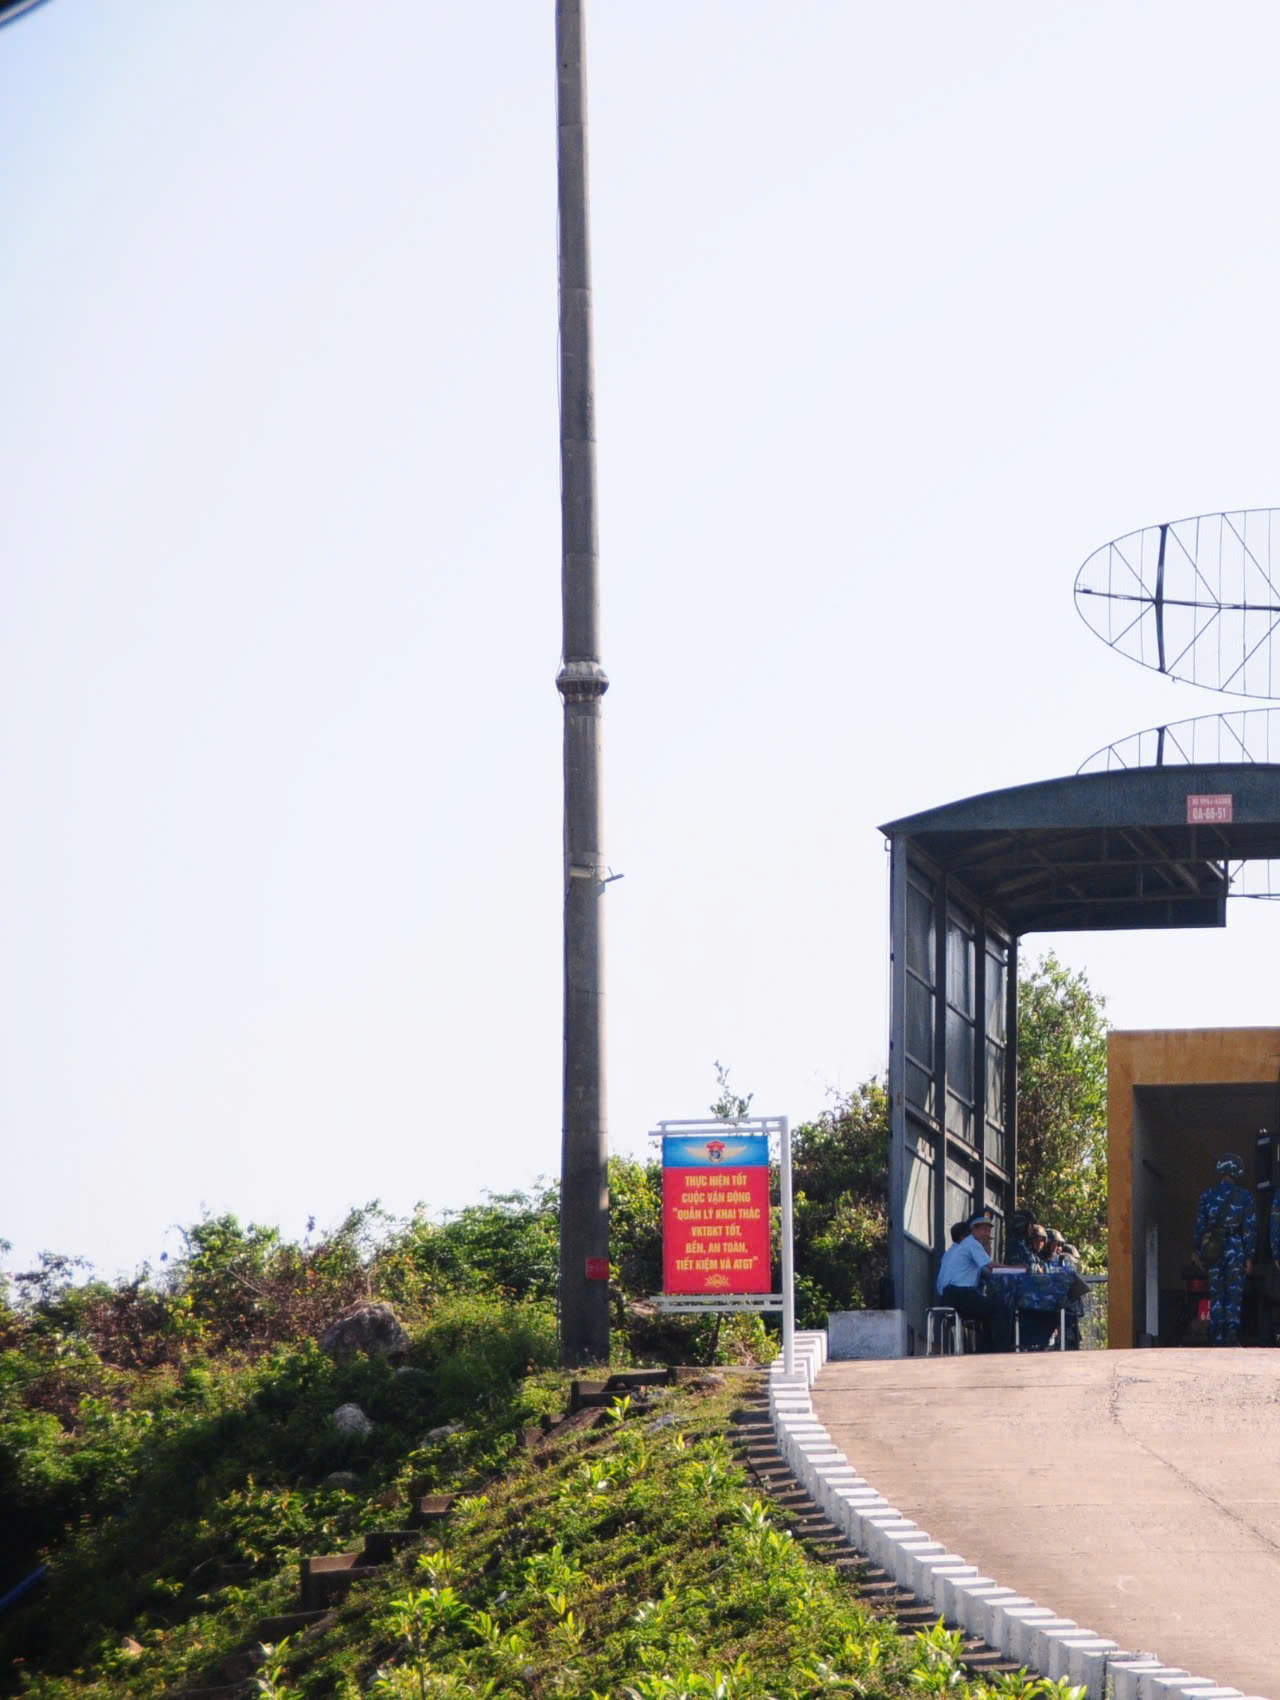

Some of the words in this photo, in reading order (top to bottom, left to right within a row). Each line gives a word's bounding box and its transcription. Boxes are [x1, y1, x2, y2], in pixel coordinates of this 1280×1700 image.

[732, 1171, 748, 1187] TỐT
[681, 1190, 705, 1206] CUỘC
[707, 1190, 725, 1204] VẬN
[715, 1208, 737, 1220] KHAI
[738, 1206, 761, 1219] THÁC
[708, 1242, 720, 1253] AN
[676, 1256, 693, 1271] TIẾT
[695, 1257, 718, 1272] KIỆM
[720, 1256, 731, 1270] VÀ
